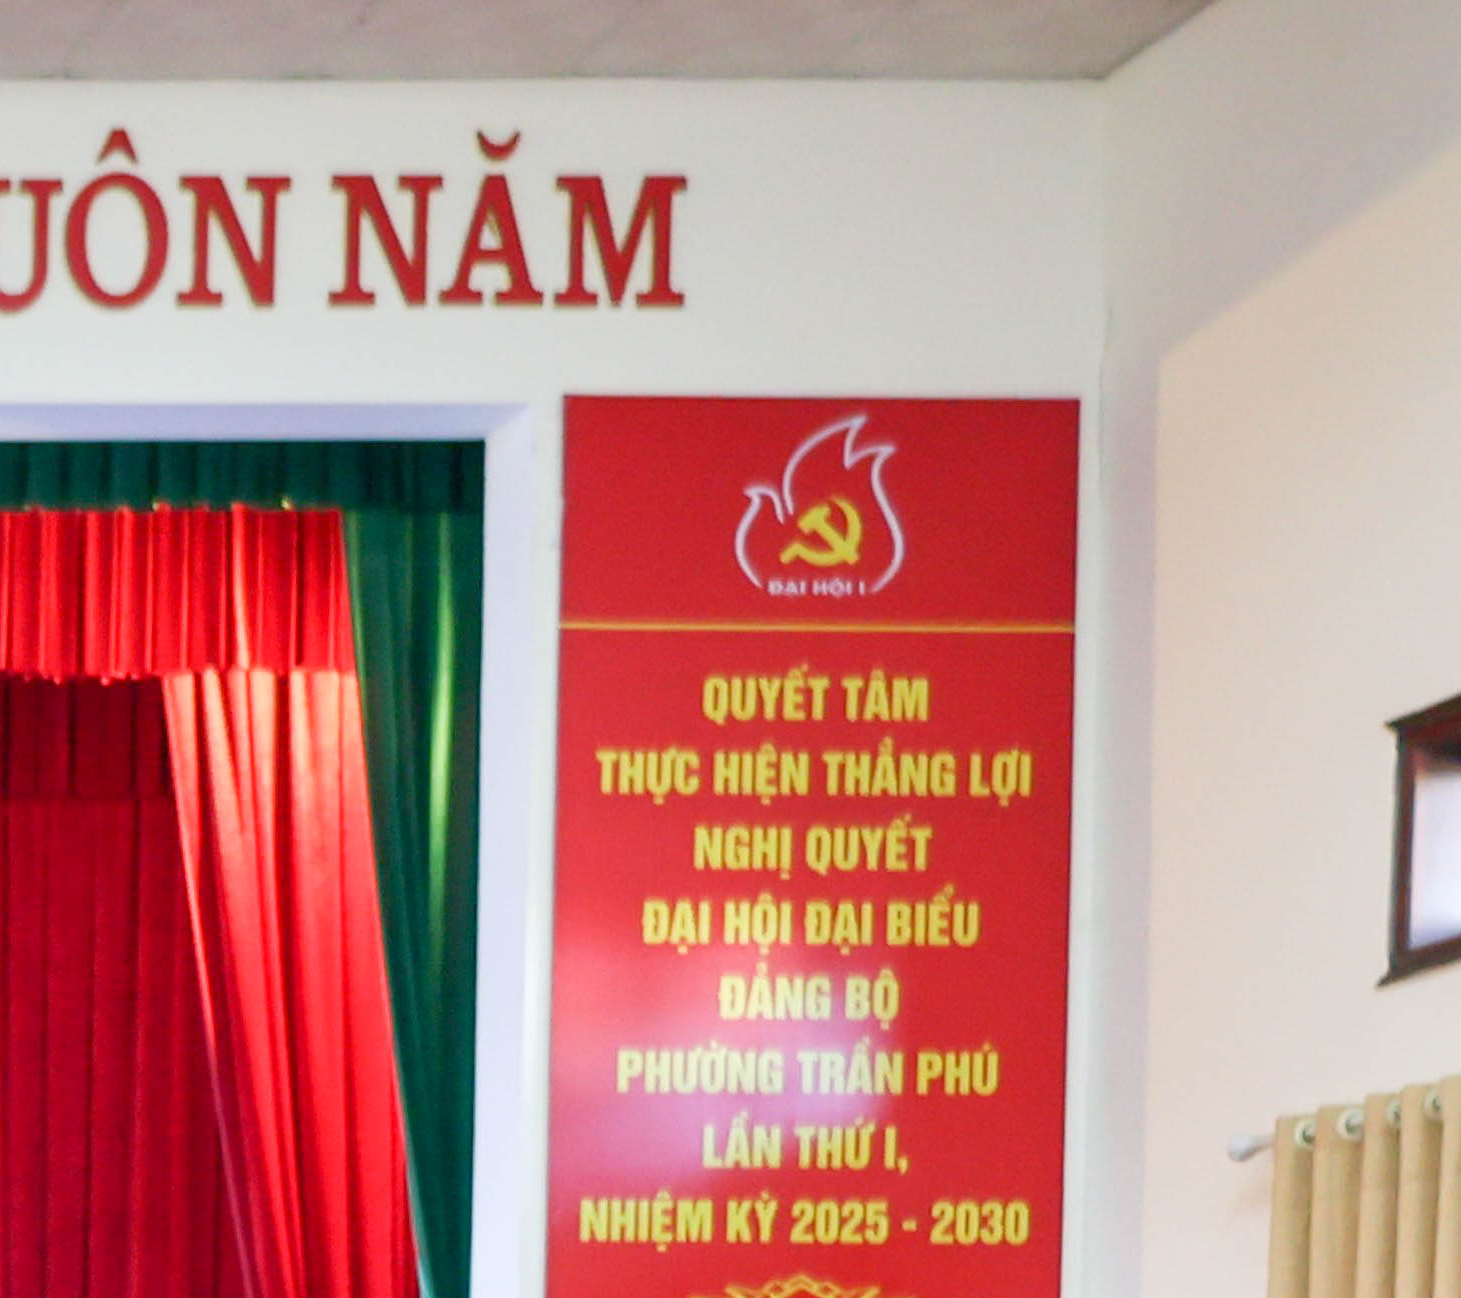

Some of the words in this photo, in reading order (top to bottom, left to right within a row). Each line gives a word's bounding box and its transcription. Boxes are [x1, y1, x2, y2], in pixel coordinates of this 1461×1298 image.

[331, 130, 685, 306] NĂM
[703, 664, 829, 725] QUYẾT
[842, 669, 929, 721] TÂM
[596, 744, 700, 805] THỰC
[714, 743, 809, 805] HIỆN
[823, 737, 956, 797] THẮNG
[970, 747, 1032, 806] LỢI
[694, 825, 792, 879] NGHỊ
[806, 813, 933, 875] QUYẾT
[642, 899, 711, 955] ĐẠI
[723, 892, 793, 957] HỘI
[804, 900, 874, 956] ĐẠI
[886, 884, 981, 946] BIỂU
[718, 963, 830, 1021] ĐẢNG
[844, 969, 900, 1030] BỘ
[615, 1038, 784, 1095] PHƯỜNG
[797, 1034, 903, 1096] TRẦN
[916, 1042, 1000, 1096] PHÚ
[701, 1110, 781, 1170] LẦN
[795, 1114, 876, 1171] THỨ
[578, 1187, 713, 1252] NHIỆM
[790, 1199, 890, 1244] 2025
[929, 1199, 1030, 1245] 2030
